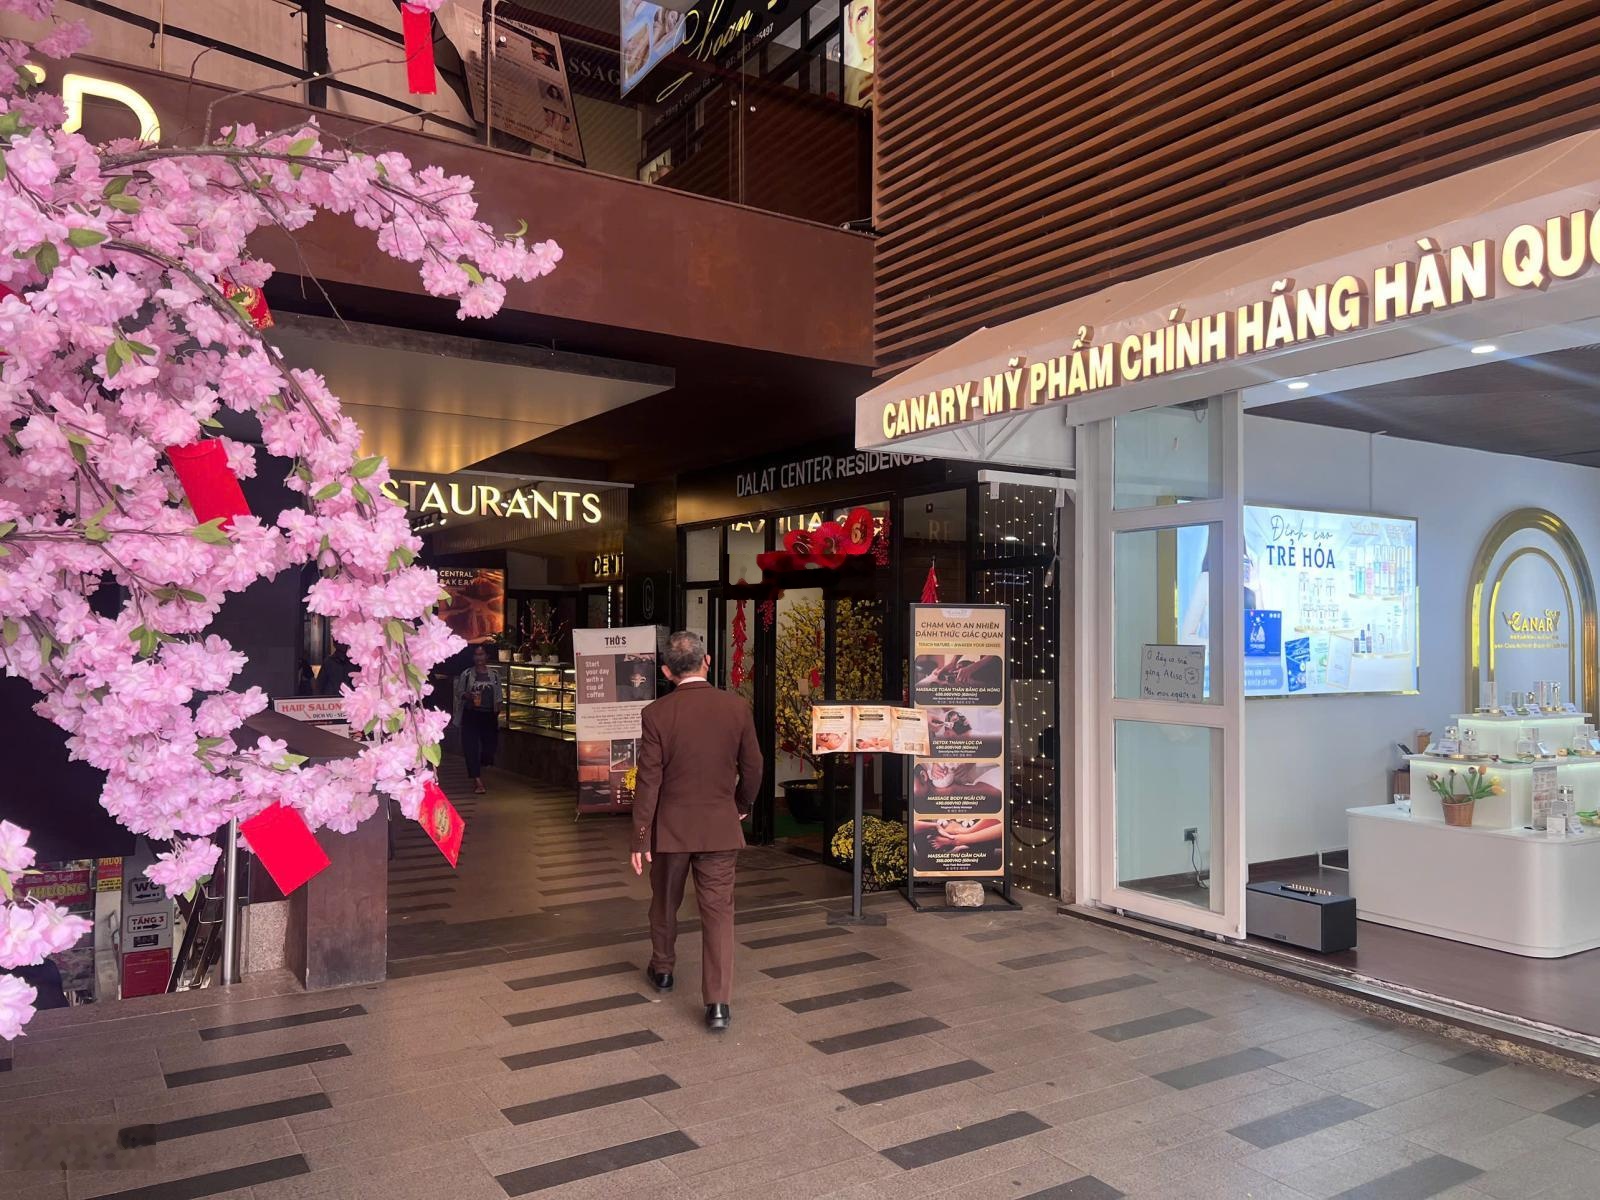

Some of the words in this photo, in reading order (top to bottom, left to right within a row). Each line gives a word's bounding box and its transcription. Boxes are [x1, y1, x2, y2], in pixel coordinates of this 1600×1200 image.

[1030, 325, 1117, 404] PHẨM
[1120, 306, 1228, 381] CHÍNH
[1238, 276, 1366, 356] HÃNG
[1373, 237, 1490, 322] HÀN
[736, 467, 777, 497] DALAT
[780, 455, 834, 489] CENTER
[836, 451, 934, 478] RESIDENCE
[1266, 539, 1296, 566] TRẺ
[1303, 542, 1336, 569] HÓA
[439, 570, 473, 578] CENTRAL
[963, 622, 974, 630] AN
[962, 629, 980, 639] GIÁC
[982, 632, 1004, 640] QUAN
[599, 668, 609, 676] day
[586, 684, 597, 692] cup
[586, 691, 605, 699] coffee
[282, 704, 304, 712] HAIR
[308, 703, 342, 711] SALON
